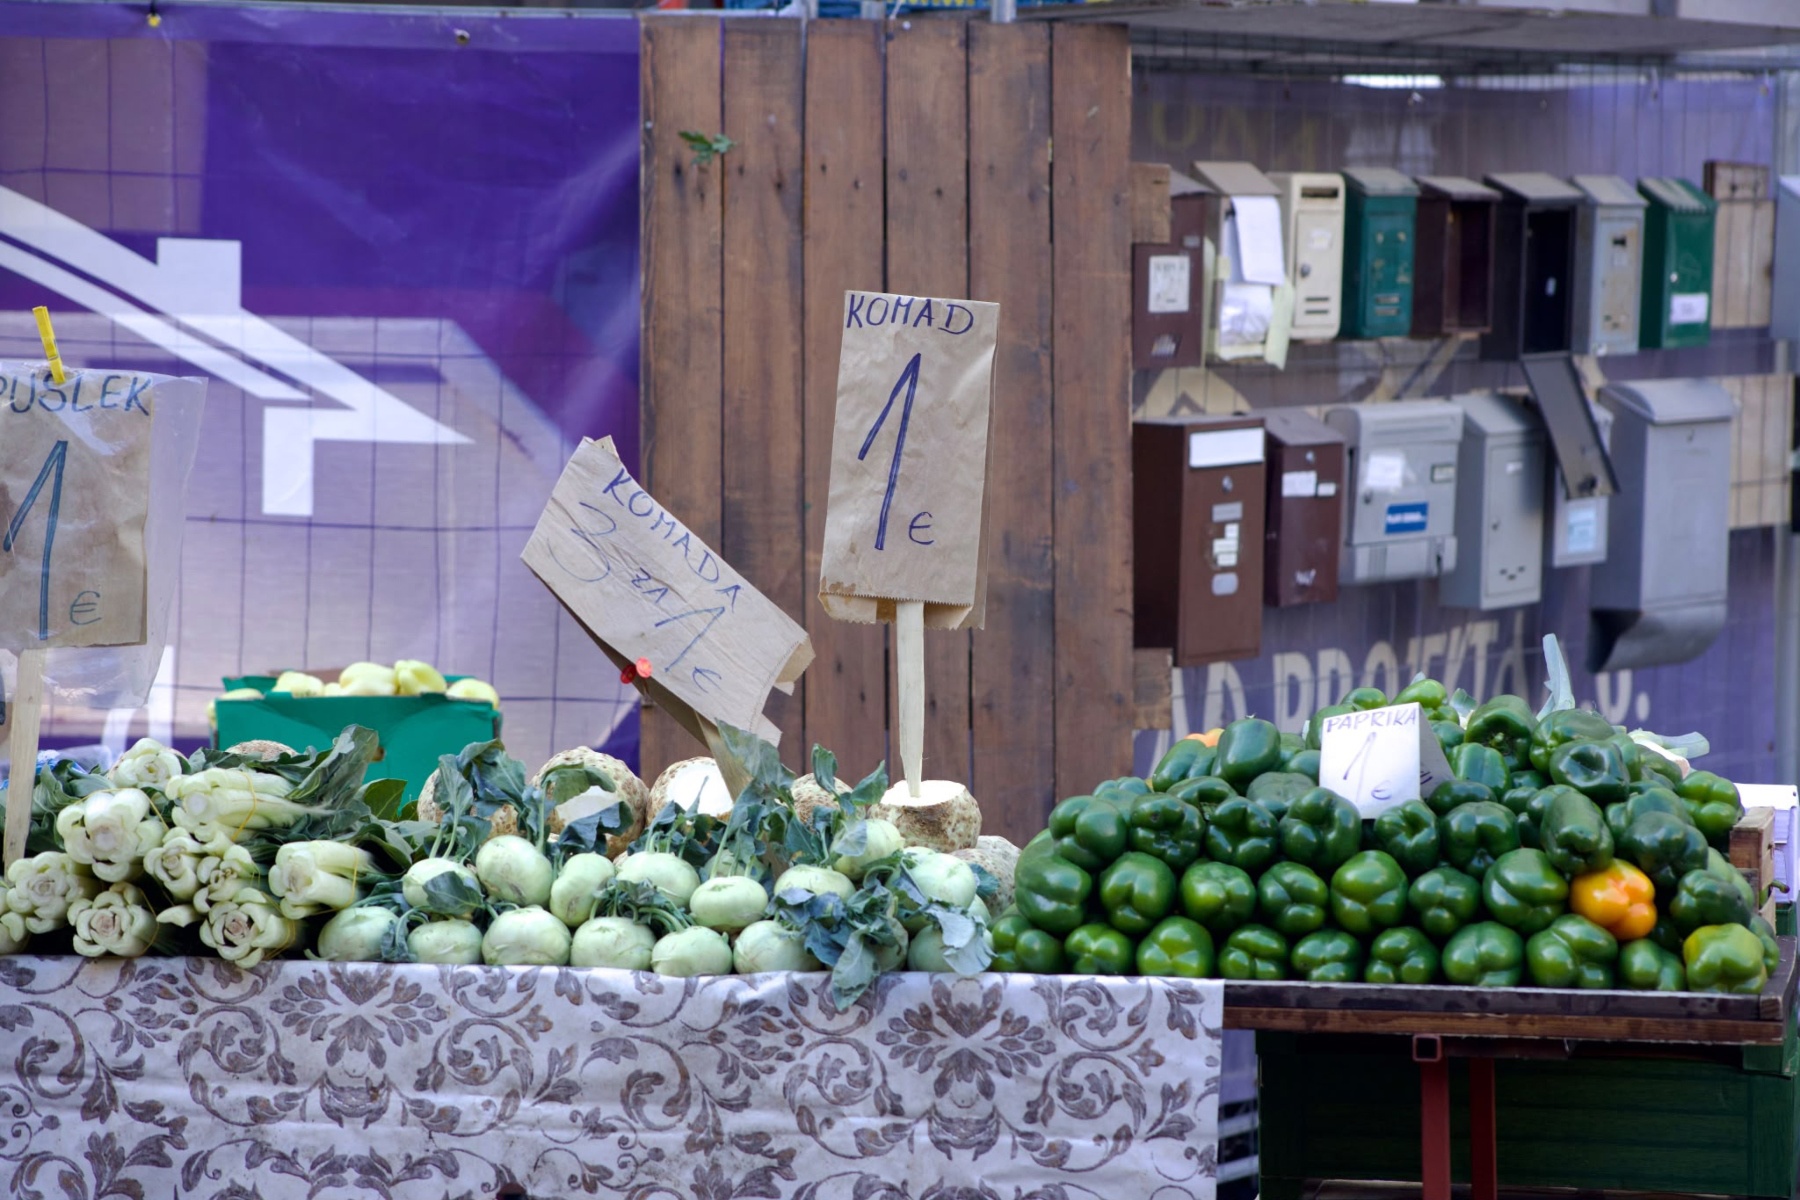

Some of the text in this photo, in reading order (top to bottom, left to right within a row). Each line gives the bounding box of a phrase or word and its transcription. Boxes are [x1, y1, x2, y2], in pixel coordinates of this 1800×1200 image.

[846, 294, 974, 335] KOMAD
[858, 352, 935, 551] 1 €
[3, 440, 102, 641] 1 €
[602, 468, 743, 613] KOMADA
[1326, 707, 1417, 733] PAPRIKA
[1342, 731, 1393, 803] 1 €
